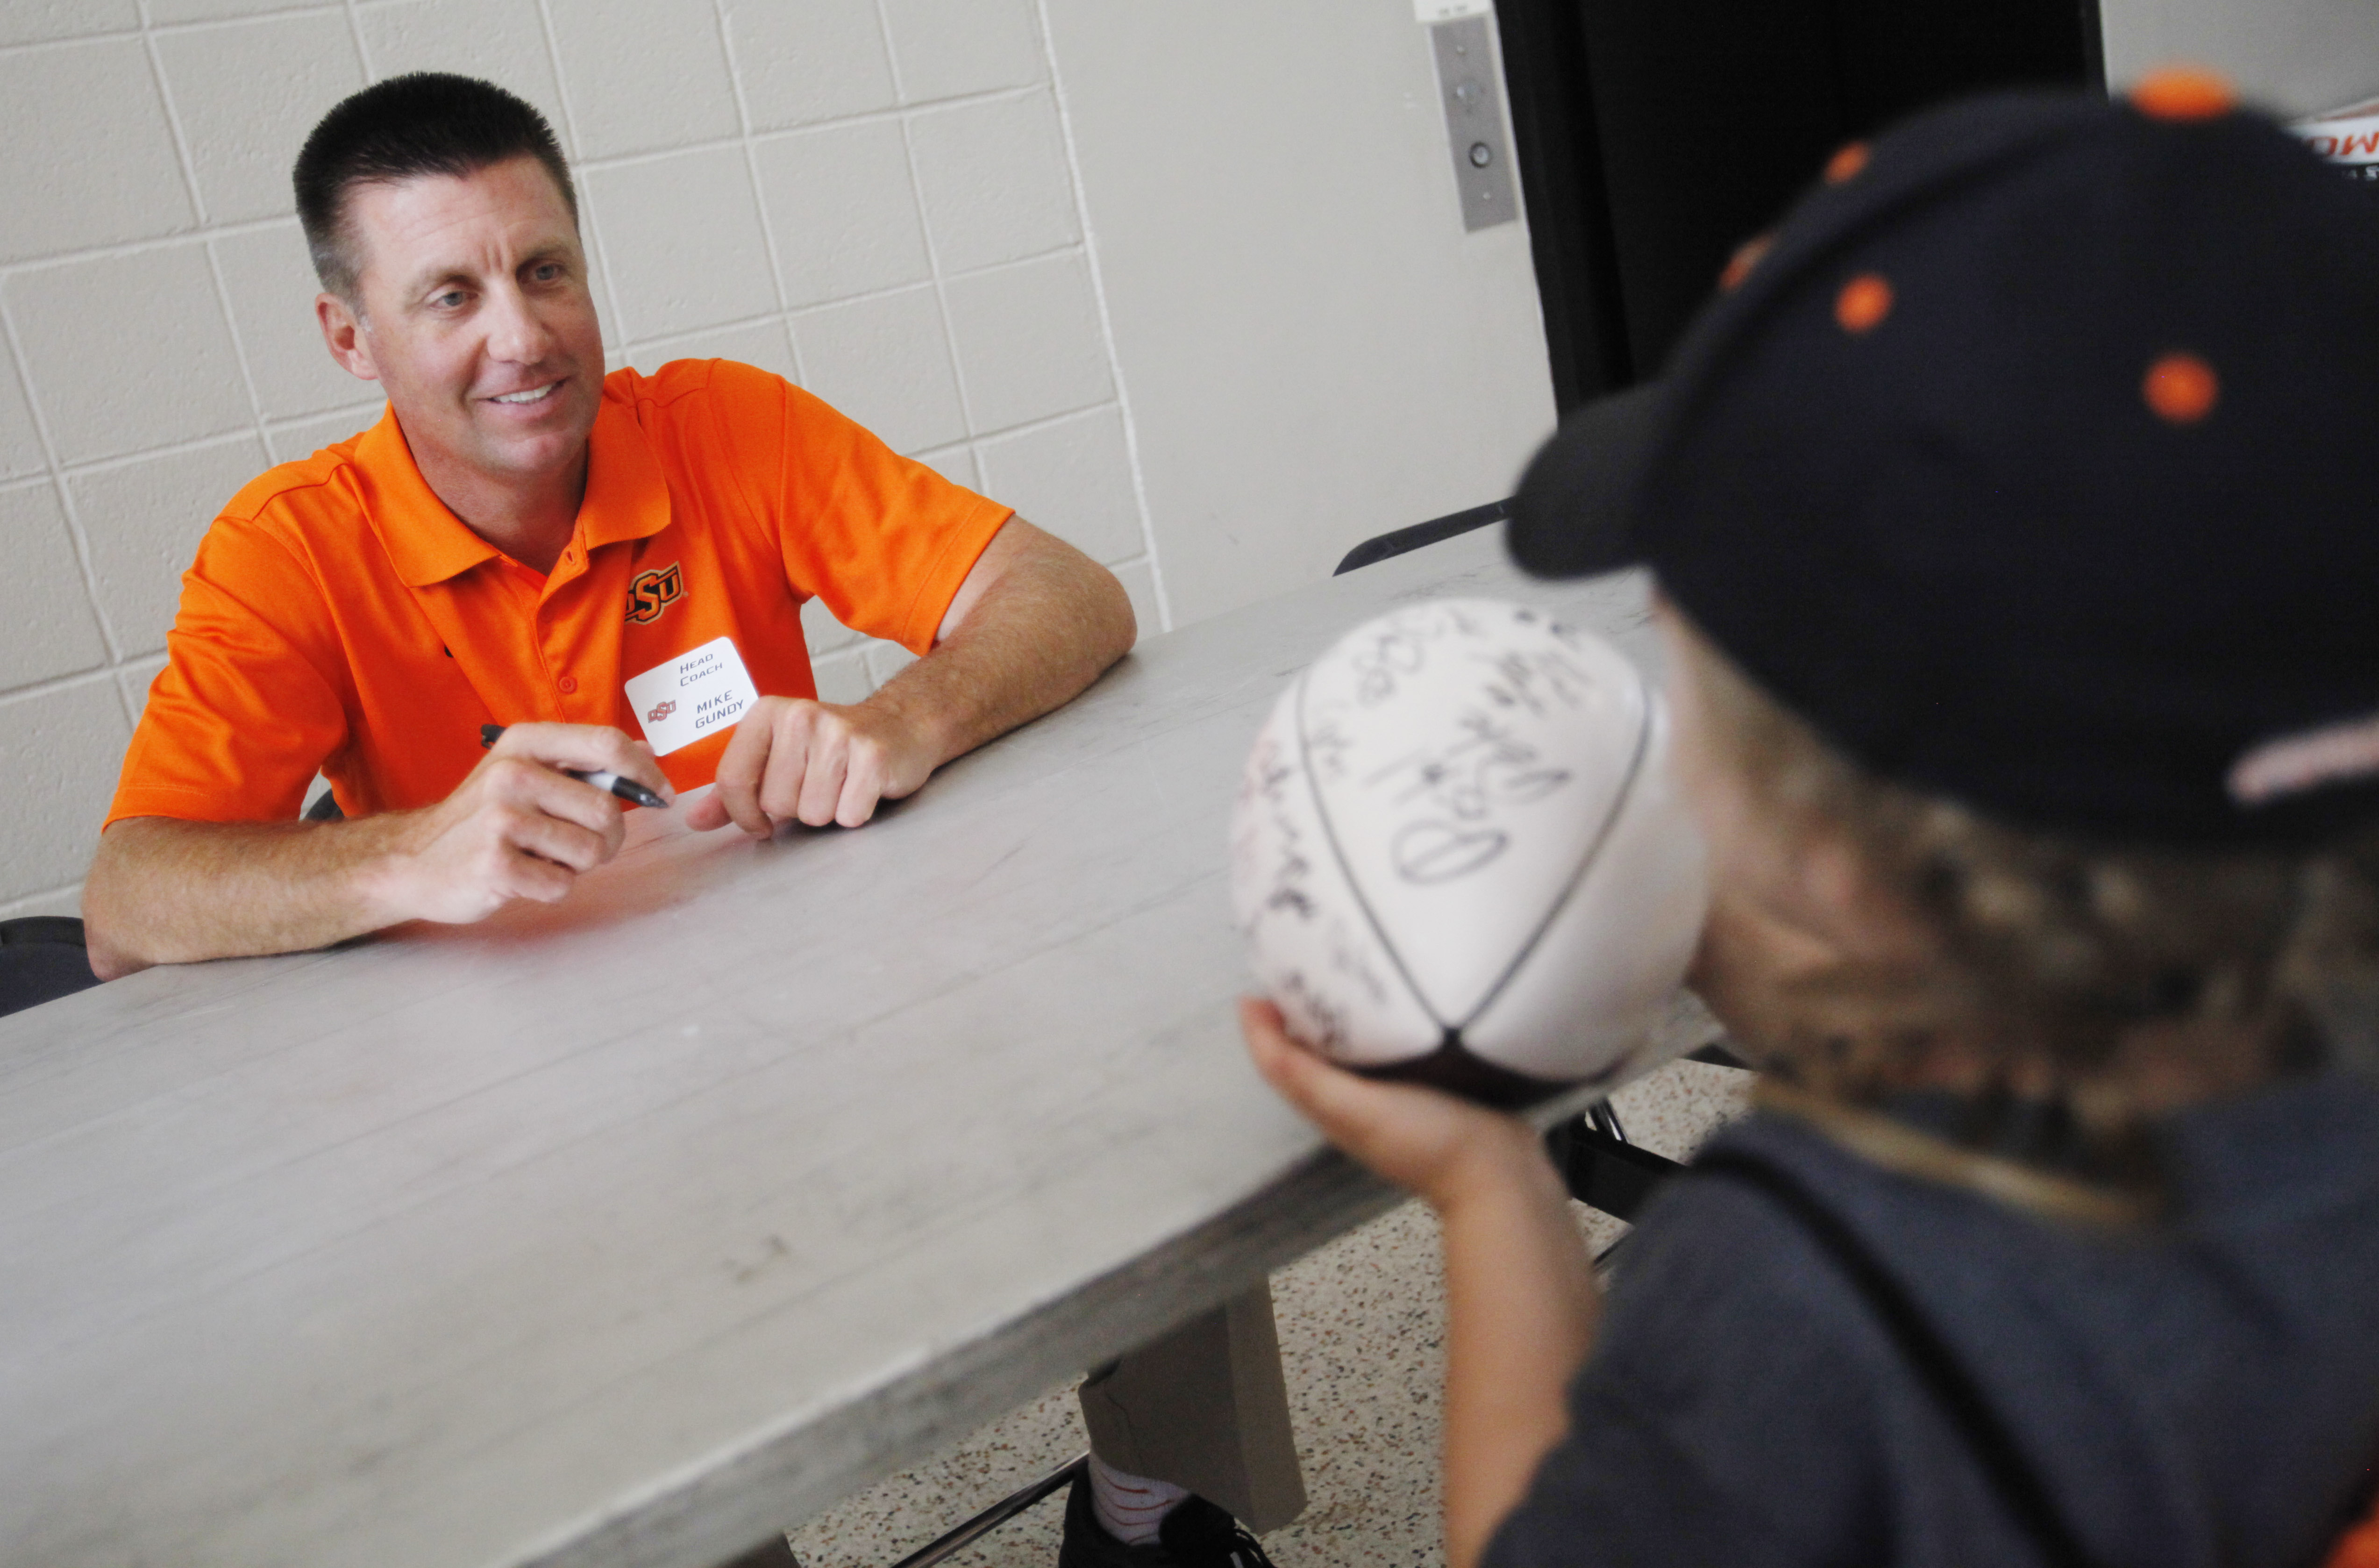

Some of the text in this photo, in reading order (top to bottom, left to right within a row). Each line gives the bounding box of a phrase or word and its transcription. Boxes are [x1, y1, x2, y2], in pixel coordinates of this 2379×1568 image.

[680, 654, 713, 674] HEAD
[680, 662, 722, 686] COACH
[648, 699, 676, 723] OSU
[696, 699, 743, 728] GUNDY
[697, 690, 733, 713] MIKE
